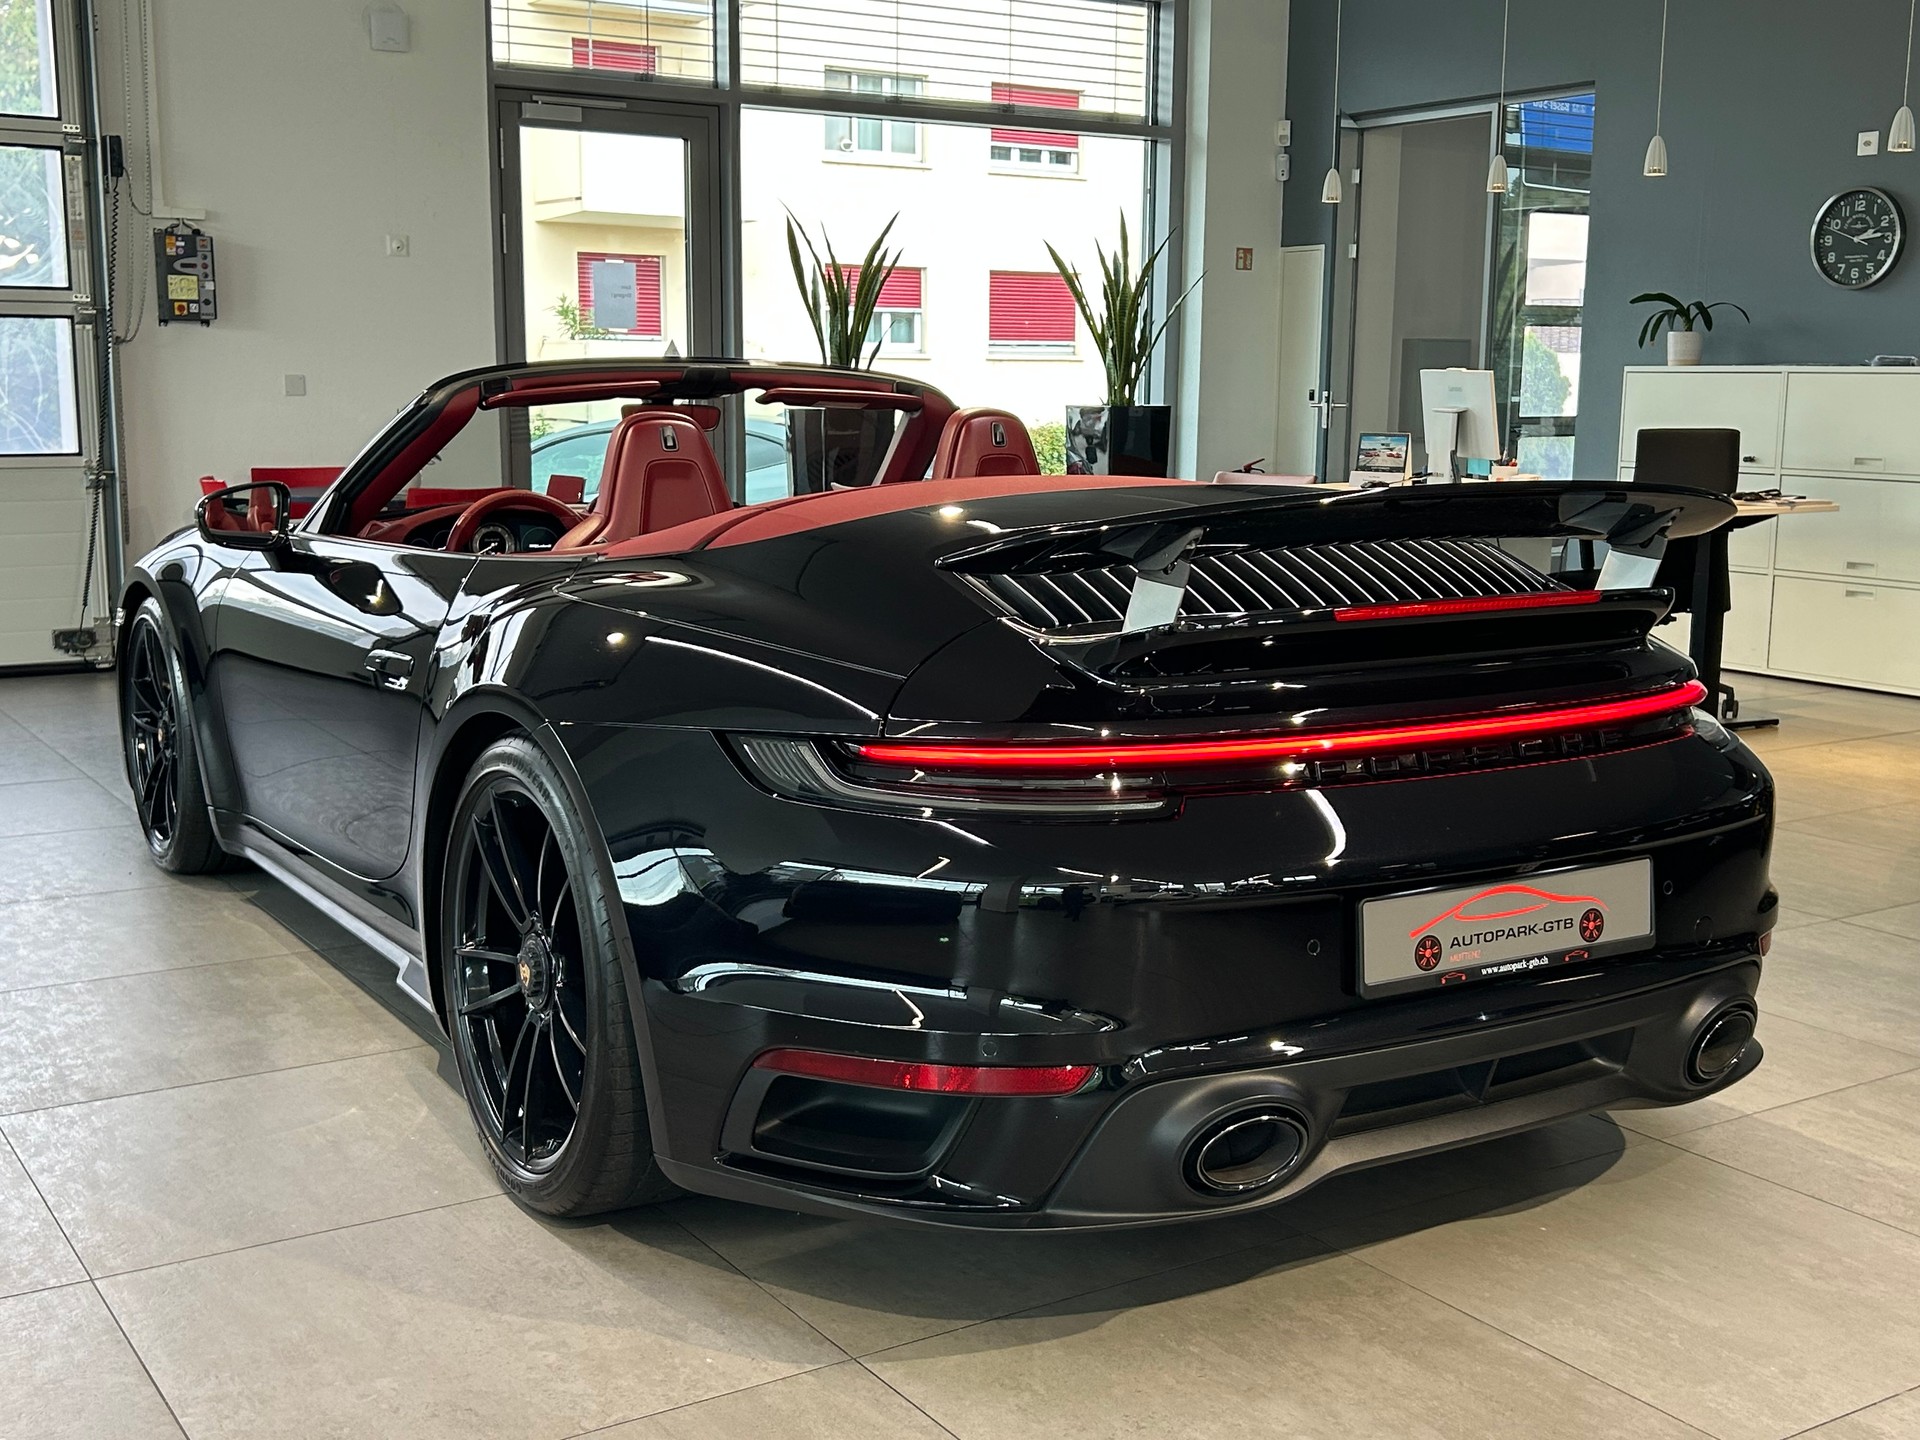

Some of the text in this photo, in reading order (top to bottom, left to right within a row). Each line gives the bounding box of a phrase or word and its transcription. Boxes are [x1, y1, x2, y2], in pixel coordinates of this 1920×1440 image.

[1855, 200, 1866, 211] 12
[1873, 203, 1877, 215] 1
[1842, 206, 1850, 217] 11
[1830, 219, 1841, 230] 10
[1880, 215, 1889, 227] 2
[1824, 235, 1832, 246] 9
[1883, 232, 1892, 243] 3
[1827, 252, 1835, 263] 8
[1876, 249, 1885, 261] 4
[1837, 263, 1846, 275] 7
[1850, 268, 1859, 278] 6
[1865, 262, 1874, 274] 5
[1450, 918, 1574, 948] AUTOPARK-GTB
[1481, 956, 1549, 975] www.autopark-gtb.ch
